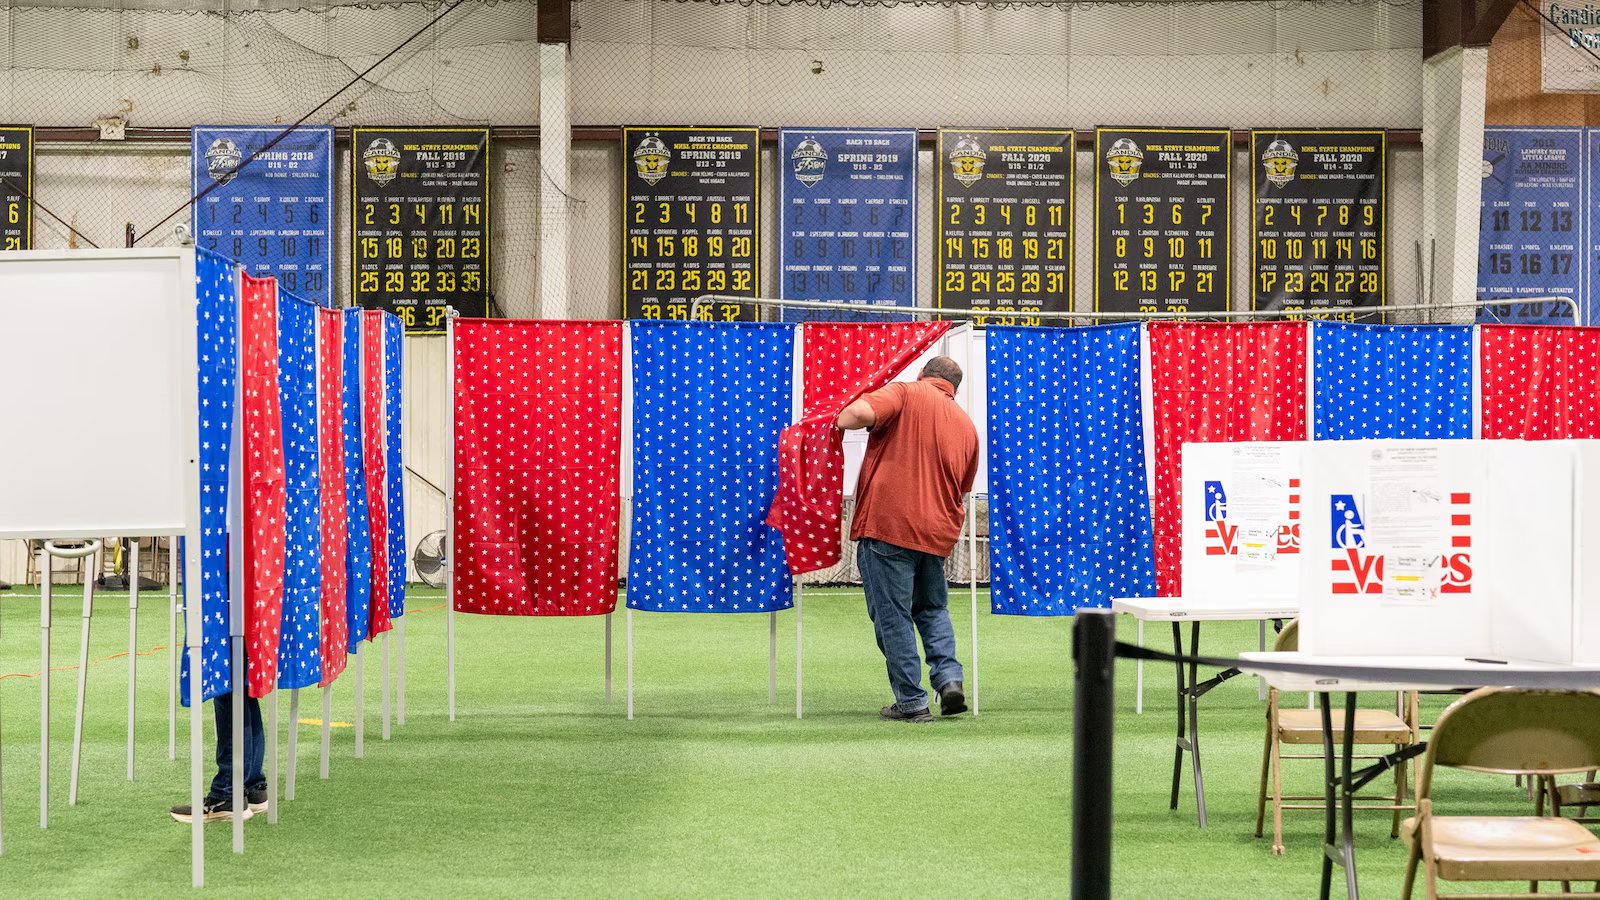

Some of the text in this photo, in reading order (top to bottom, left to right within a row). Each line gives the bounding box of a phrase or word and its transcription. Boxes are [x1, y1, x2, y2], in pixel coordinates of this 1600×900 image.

[253, 152, 314, 160] SPRING 2018
[416, 152, 465, 160] FALL 2018
[681, 151, 741, 159] SPRING 2019
[838, 154, 898, 162] SPRING 2019
[950, 150, 985, 158] CANDIA
[1001, 154, 1051, 162] FALL 2020
[1158, 153, 1208, 161] FALL 2020
[1314, 154, 1362, 162] FALL 2020
[9, 203, 18, 223] 6
[210, 204, 319, 224] 1 2 4 5 6
[366, 204, 479, 224] 2 3 4 11 14
[636, 203, 747, 223] 2 3 4 8 11
[951, 204, 1061, 226] 2 3 4 8 11
[1118, 204, 1211, 224] 1 3 6 7
[1266, 205, 1373, 225] 2 4 7 8 9
[1493, 210, 1573, 232] 11 12 13
[361, 238, 479, 258] 15 18 19 20 23
[632, 236, 750, 257] 14 15 18 19 20
[946, 238, 1062, 259] 14 15 18 19 21
[1116, 237, 1211, 258] 8 9 10 11
[1261, 239, 1375, 259] 10 10 11 14 16
[1490, 254, 1573, 274] 15 16 17
[361, 272, 480, 292] 25 29 32 33 35
[633, 270, 750, 290] 21 23 25 29 32
[946, 271, 1063, 292] 23 24 25 29 31
[1113, 271, 1212, 292] 12 13 17 21
[1261, 272, 1377, 292] 17 23 24 27 28
[426, 307, 446, 326] 37
